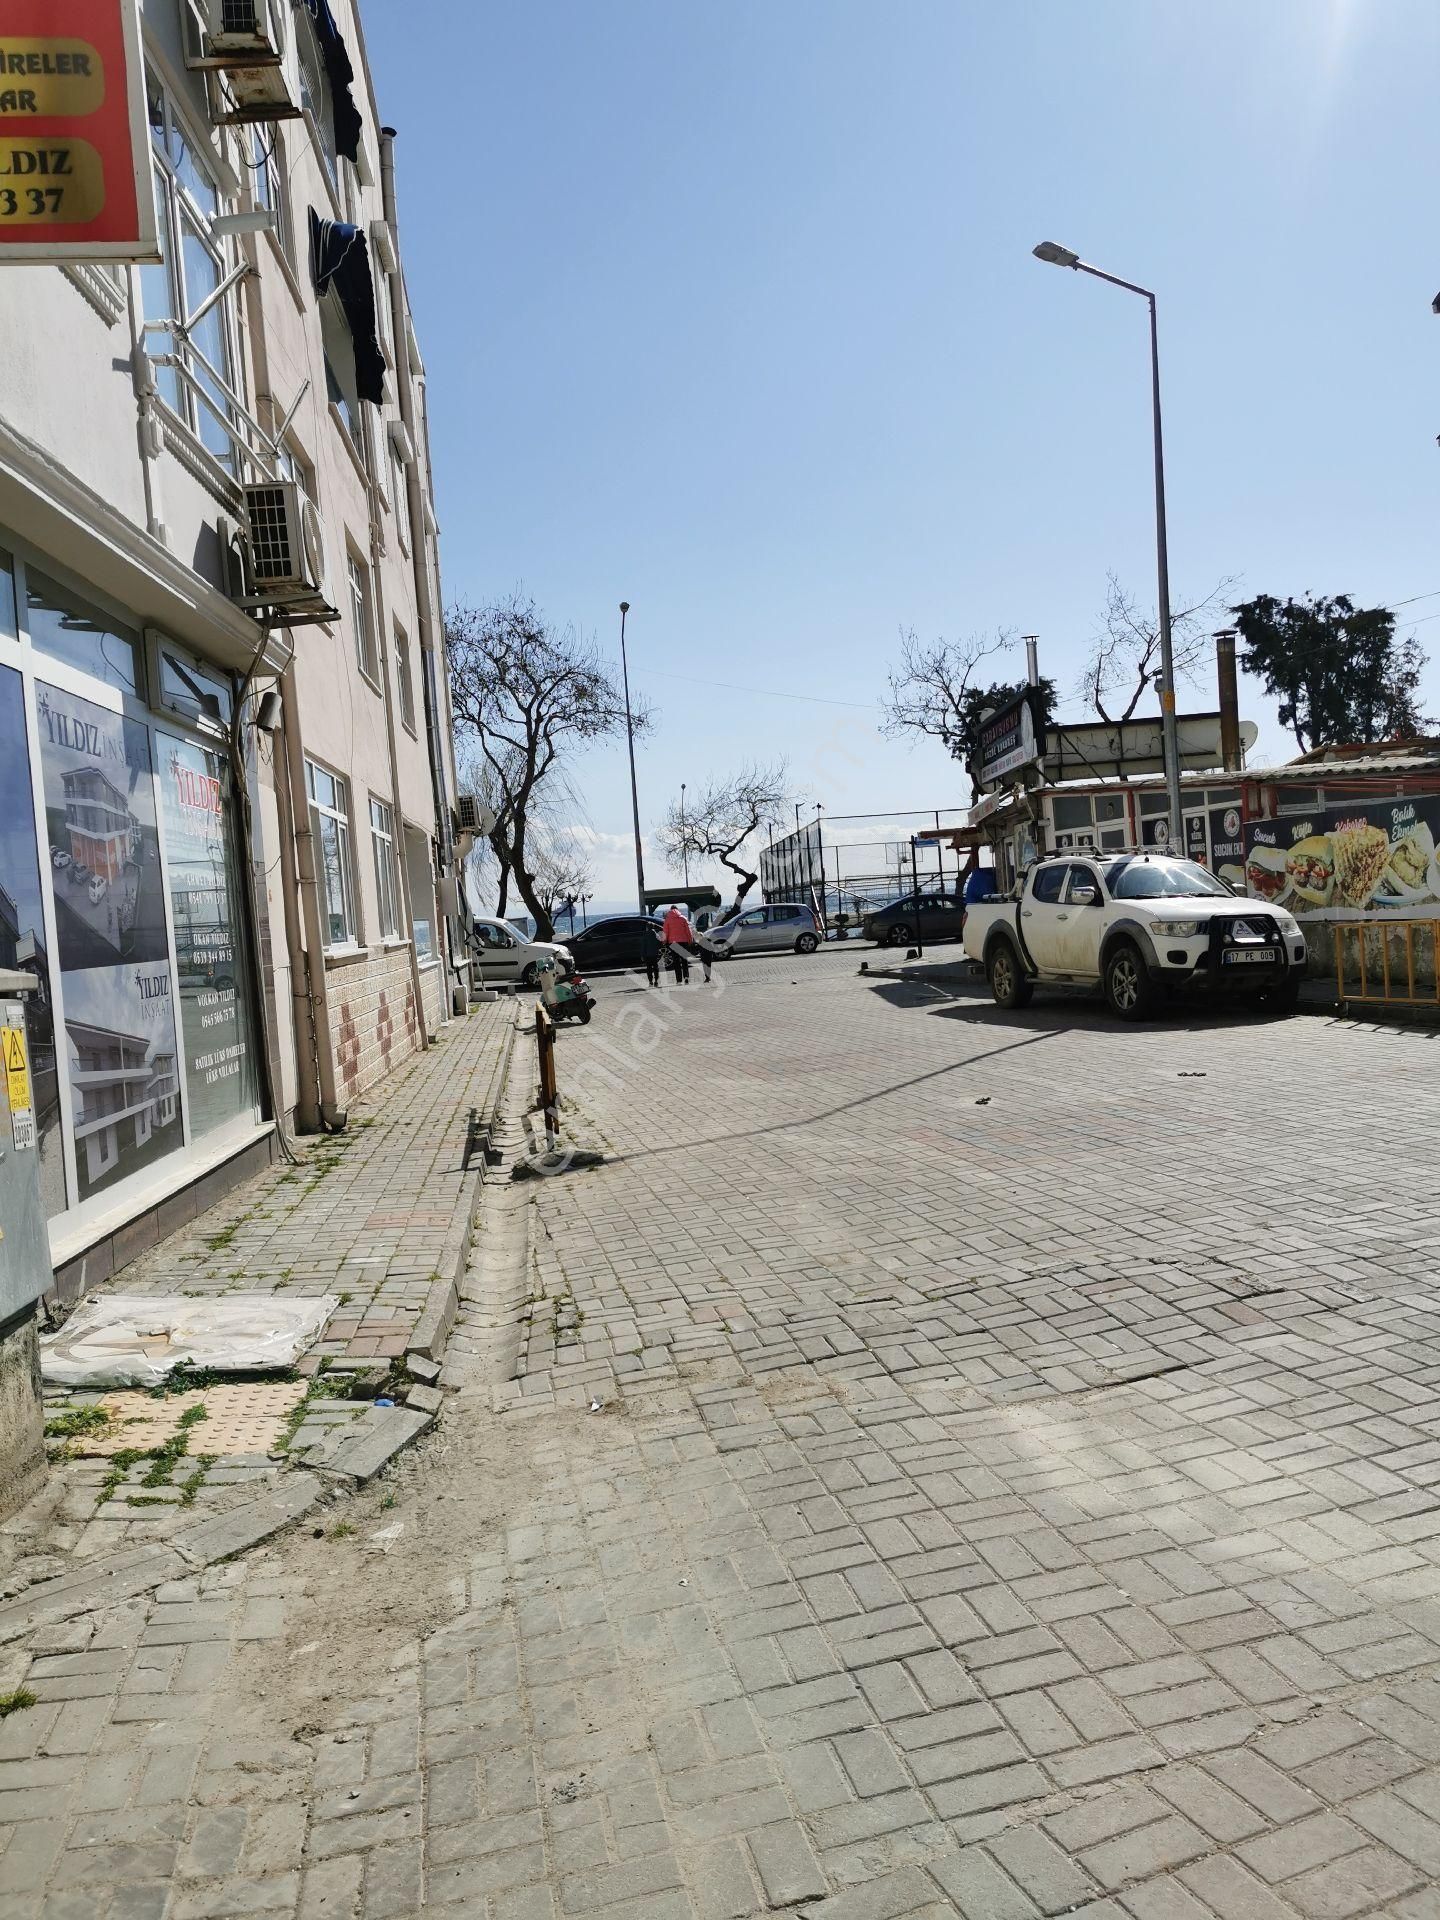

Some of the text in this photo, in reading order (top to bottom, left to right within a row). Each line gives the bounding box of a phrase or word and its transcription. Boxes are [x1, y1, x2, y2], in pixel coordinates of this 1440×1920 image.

[25, 188, 64, 215] 37
[43, 709, 101, 757] YILDIZ
[175, 766, 222, 815] YILDIZ
[1253, 828, 1277, 845] Sucuk
[1214, 843, 1233, 857] SUCUK
[1231, 951, 1274, 961] 17 PE 009
[138, 975, 169, 999] YILDIZ
[218, 988, 235, 1003] YILDIZ
